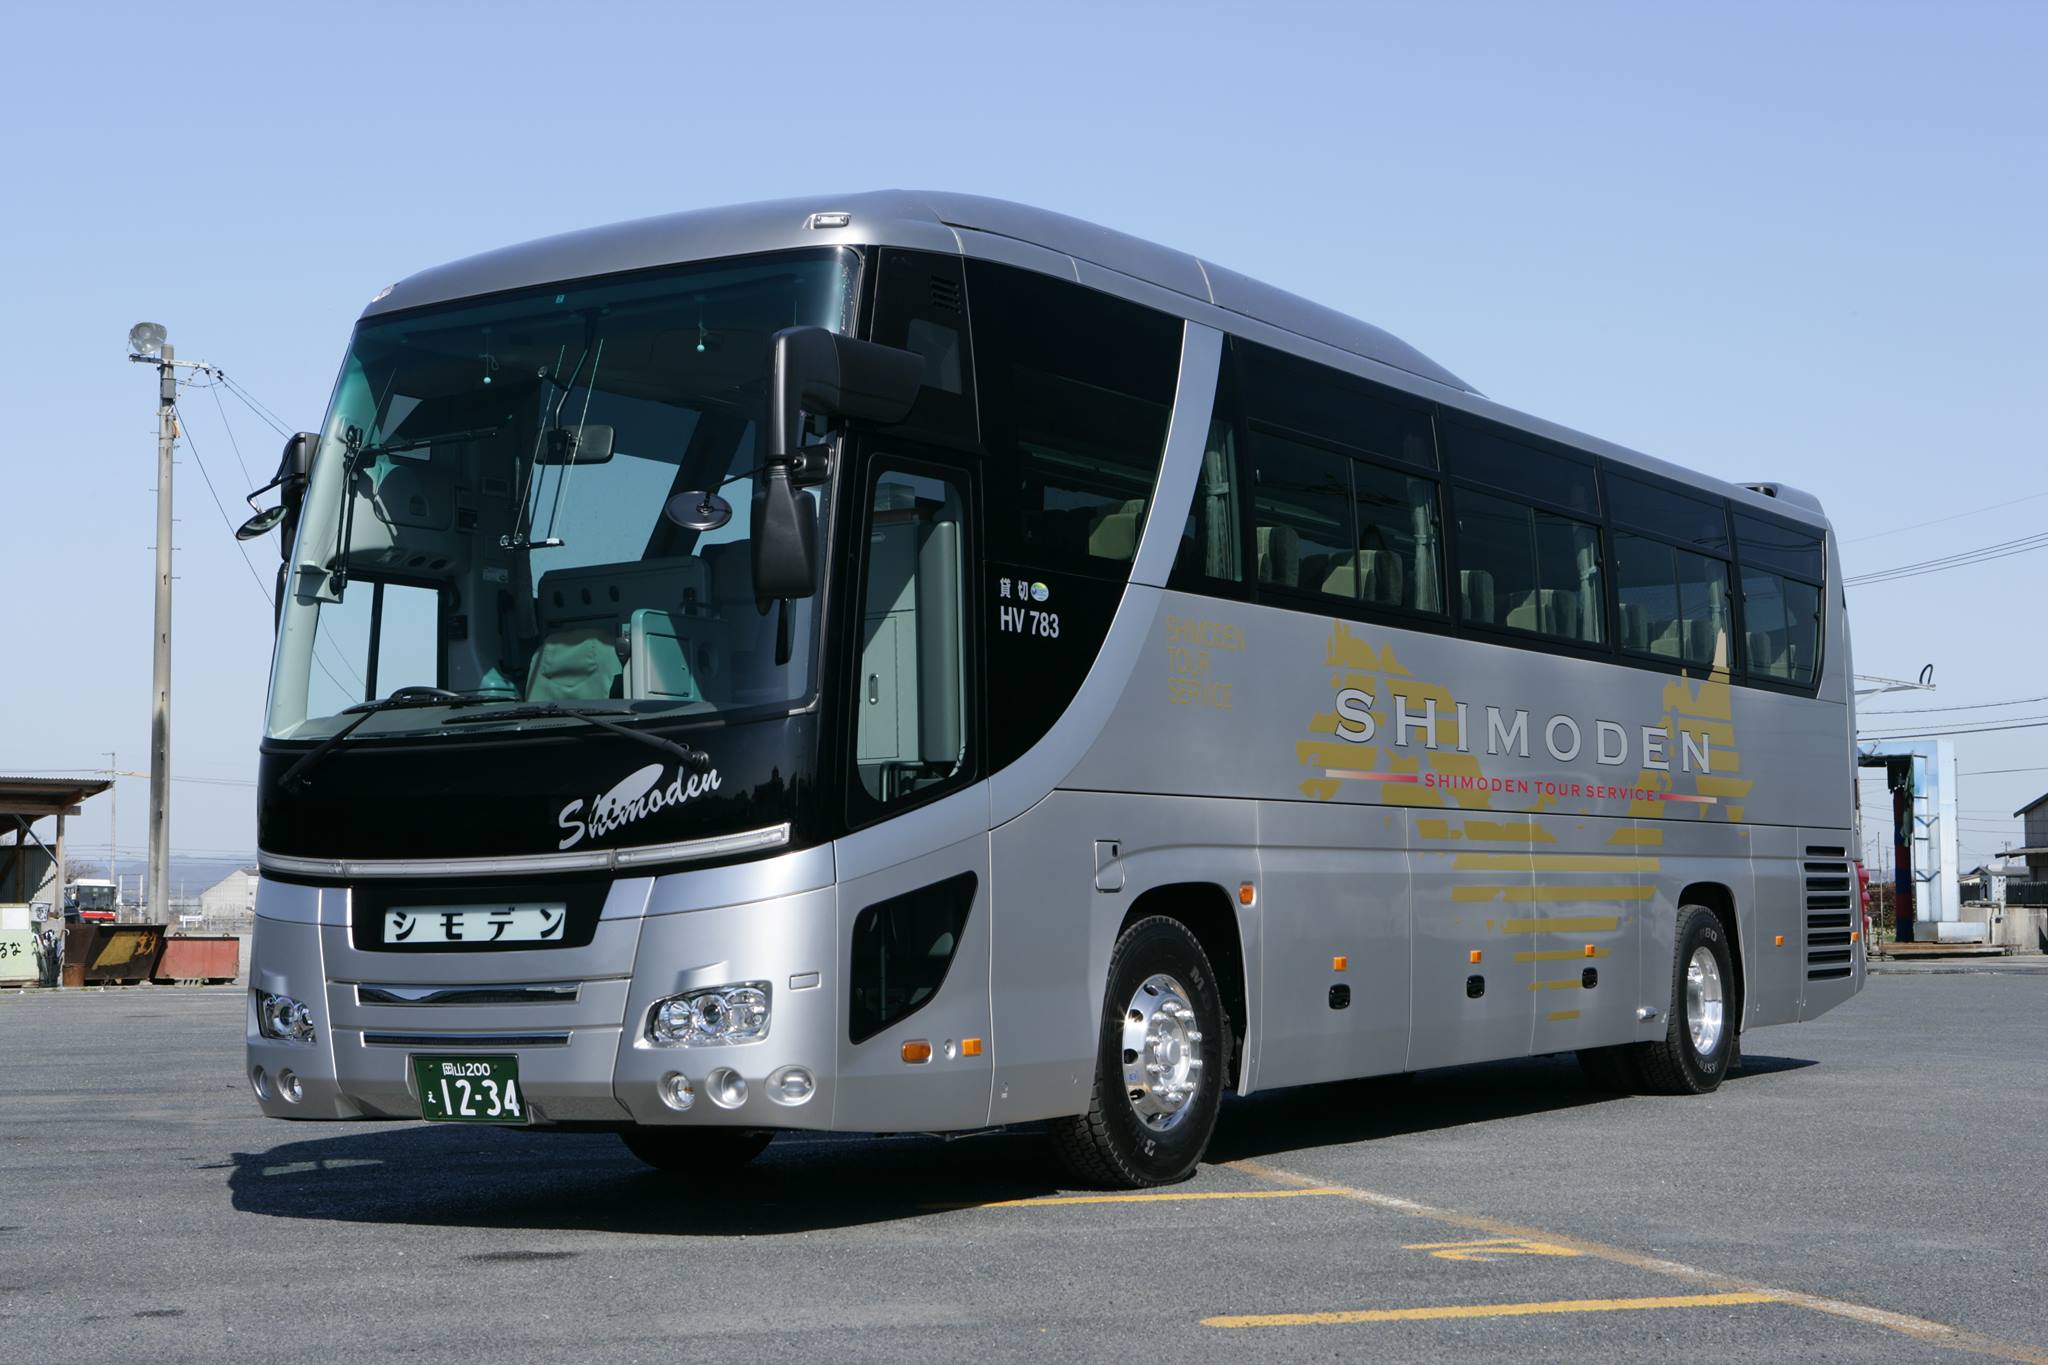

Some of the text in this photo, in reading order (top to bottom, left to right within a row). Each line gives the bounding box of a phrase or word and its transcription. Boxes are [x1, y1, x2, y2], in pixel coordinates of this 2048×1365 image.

[1000, 577, 1028, 601] 貸切
[1000, 605, 1059, 638] HV 783
[1335, 687, 1712, 774] SHIMODEN
[1425, 773, 1656, 802] SHIMODEN TOUR SERVICE
[558, 764, 722, 850] Shimoden
[393, 906, 564, 942] シモデン
[441, 1079, 520, 1117] 12-34
